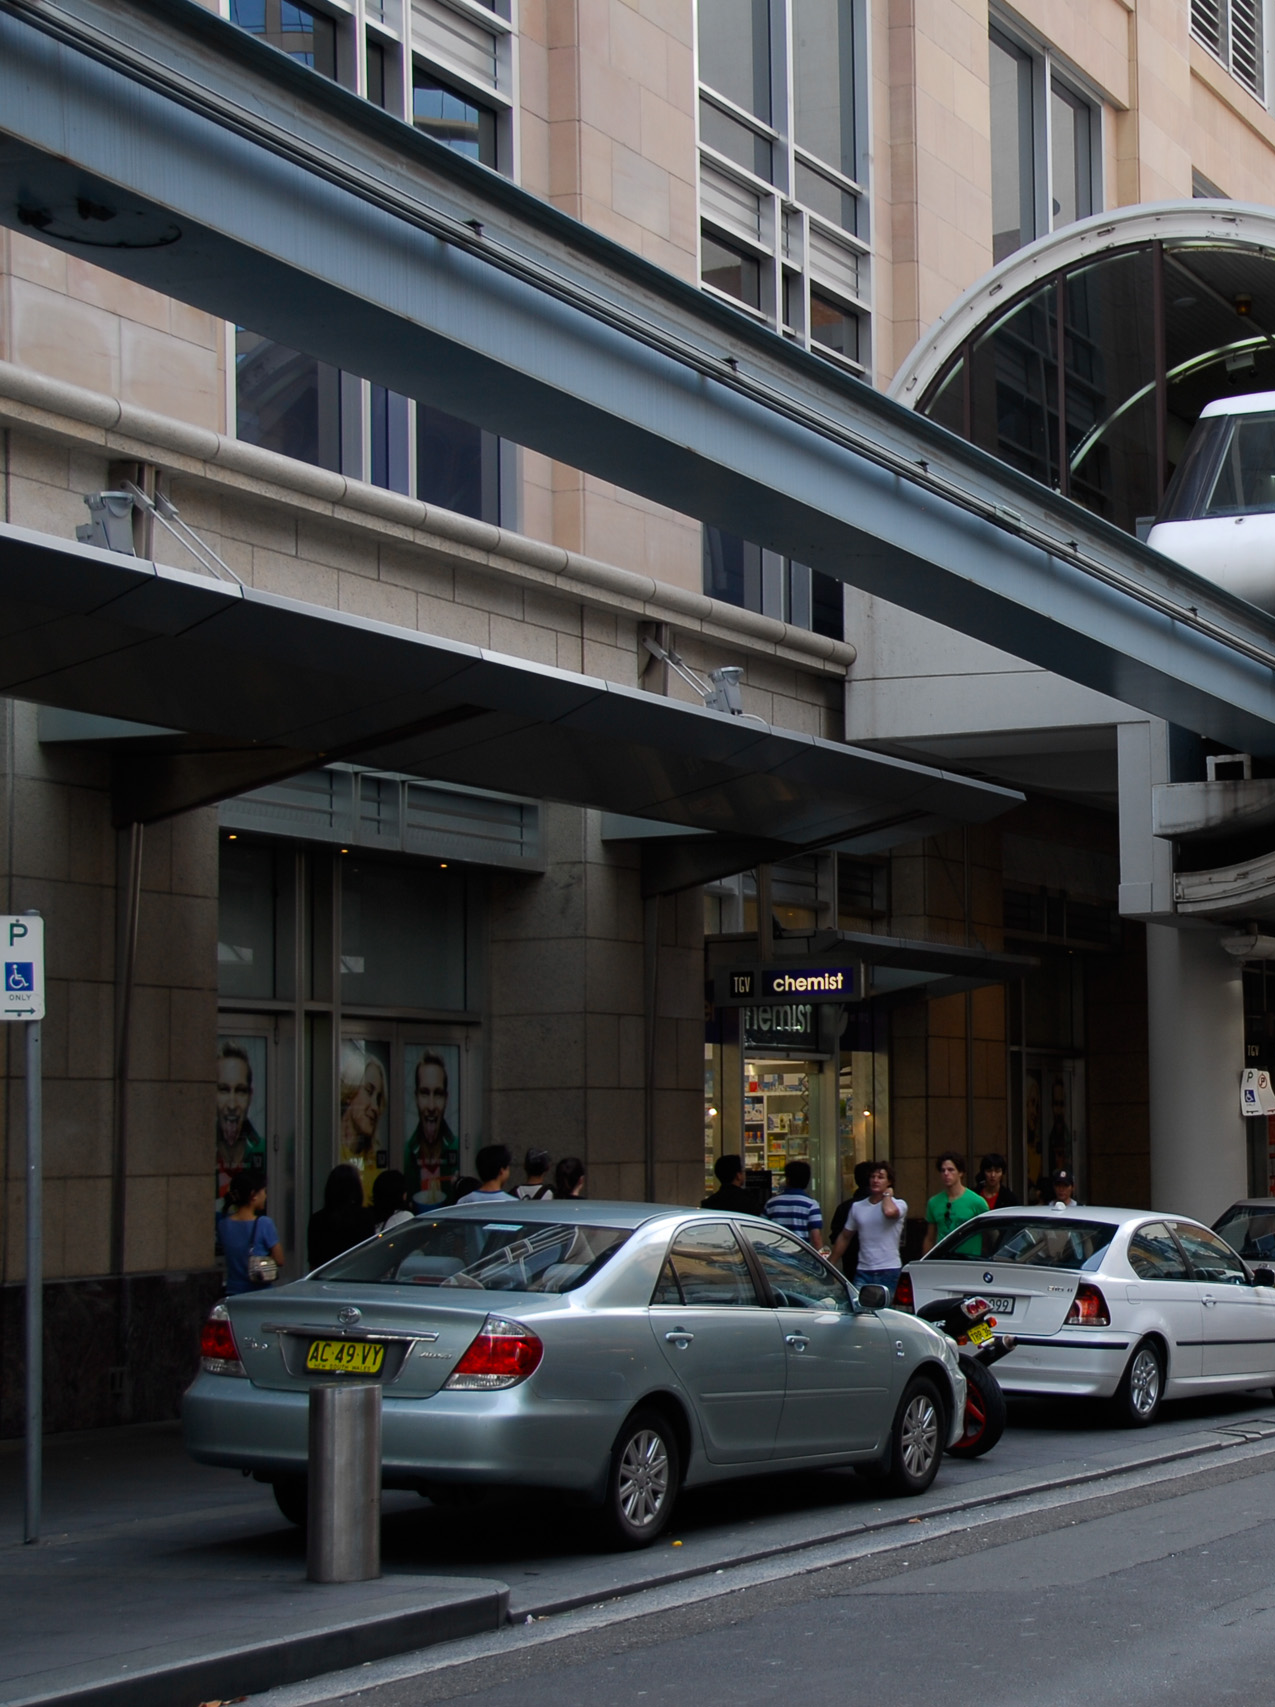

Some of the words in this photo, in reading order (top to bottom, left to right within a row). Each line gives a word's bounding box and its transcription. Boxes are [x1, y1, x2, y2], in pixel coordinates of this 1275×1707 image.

[9, 923, 28, 946] P
[734, 976, 750, 993] TGV
[773, 973, 843, 992] chemist
